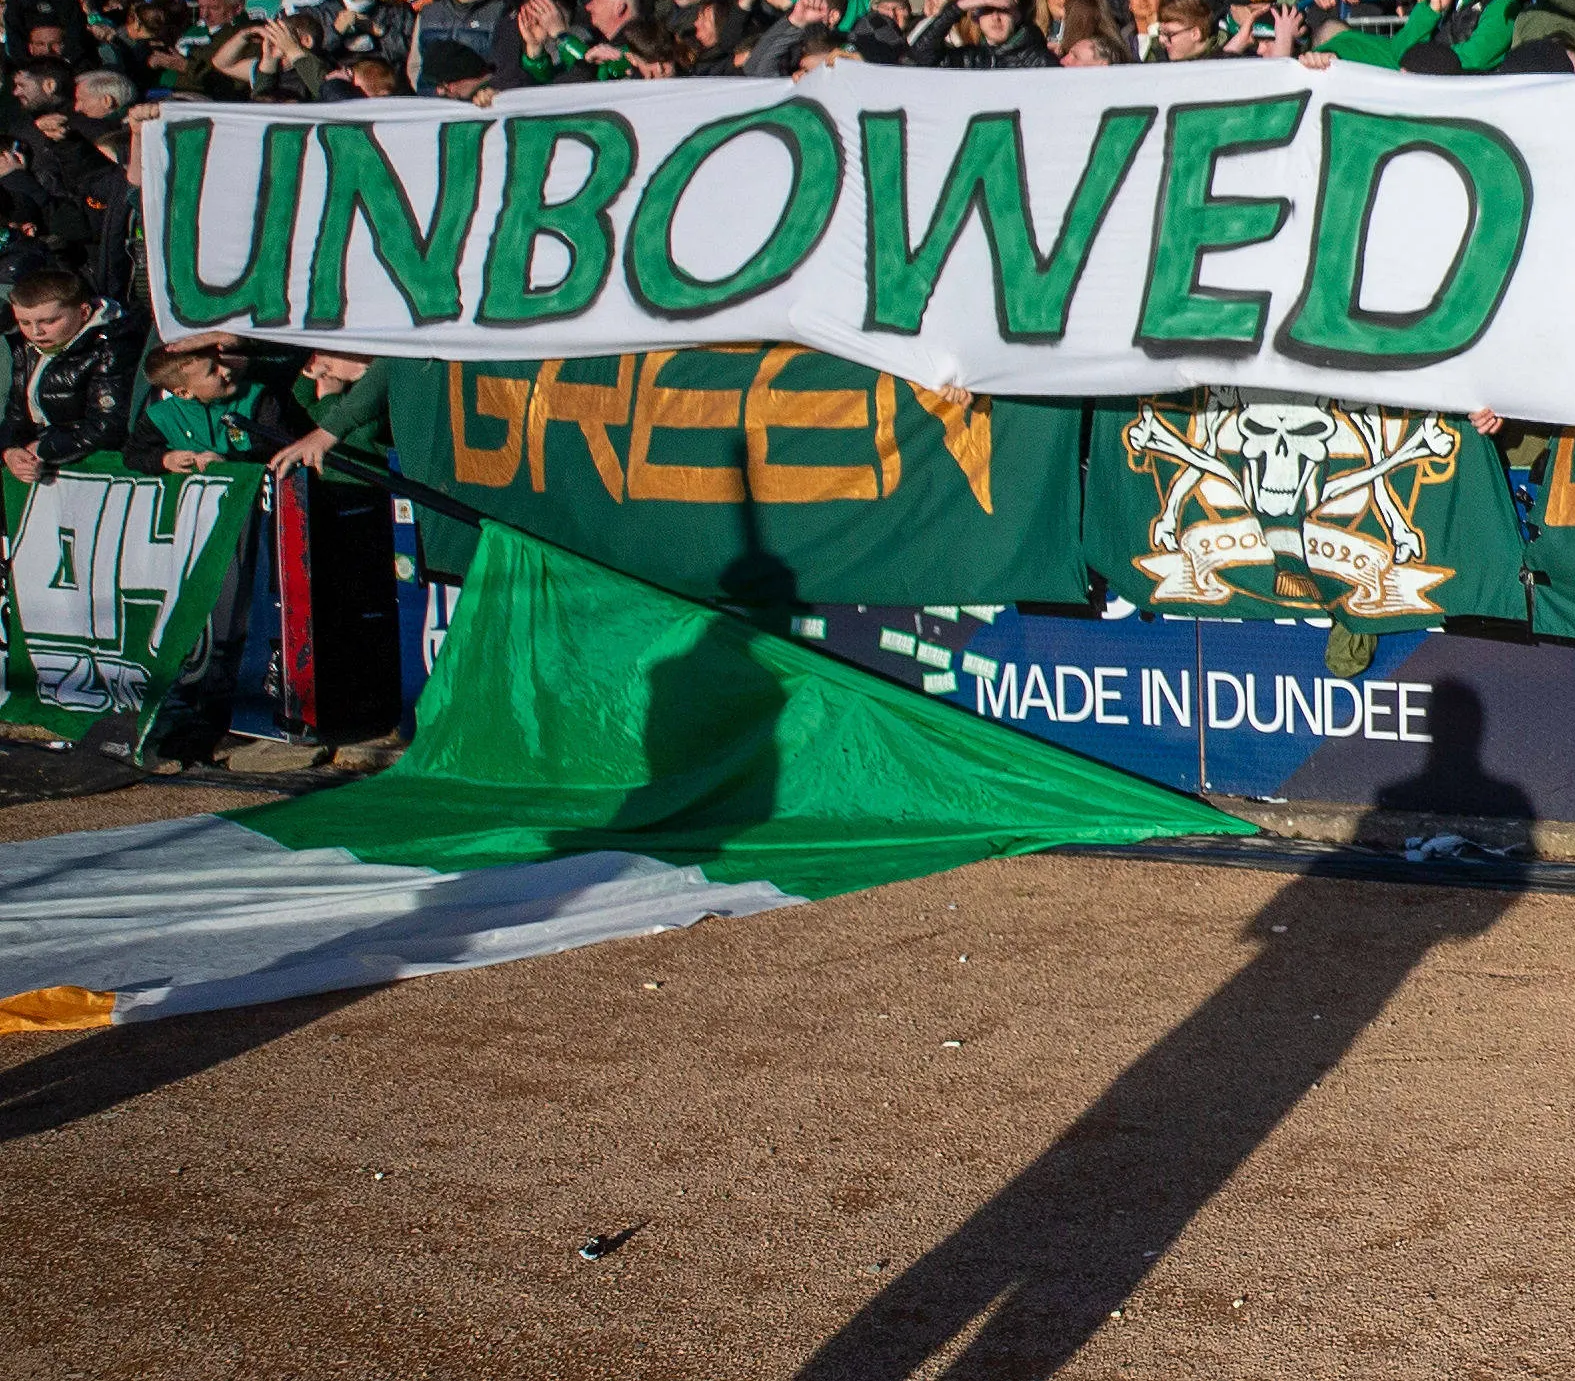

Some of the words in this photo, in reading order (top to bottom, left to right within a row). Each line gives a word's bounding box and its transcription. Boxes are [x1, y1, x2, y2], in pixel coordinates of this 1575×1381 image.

[162, 90, 1534, 370] UNBOWED
[449, 341, 994, 514] GREEN
[1308, 537, 1370, 570] 2026
[976, 663, 1129, 725] MADE
[1141, 668, 1191, 727] IN
[1208, 671, 1434, 743] DUNDEE
